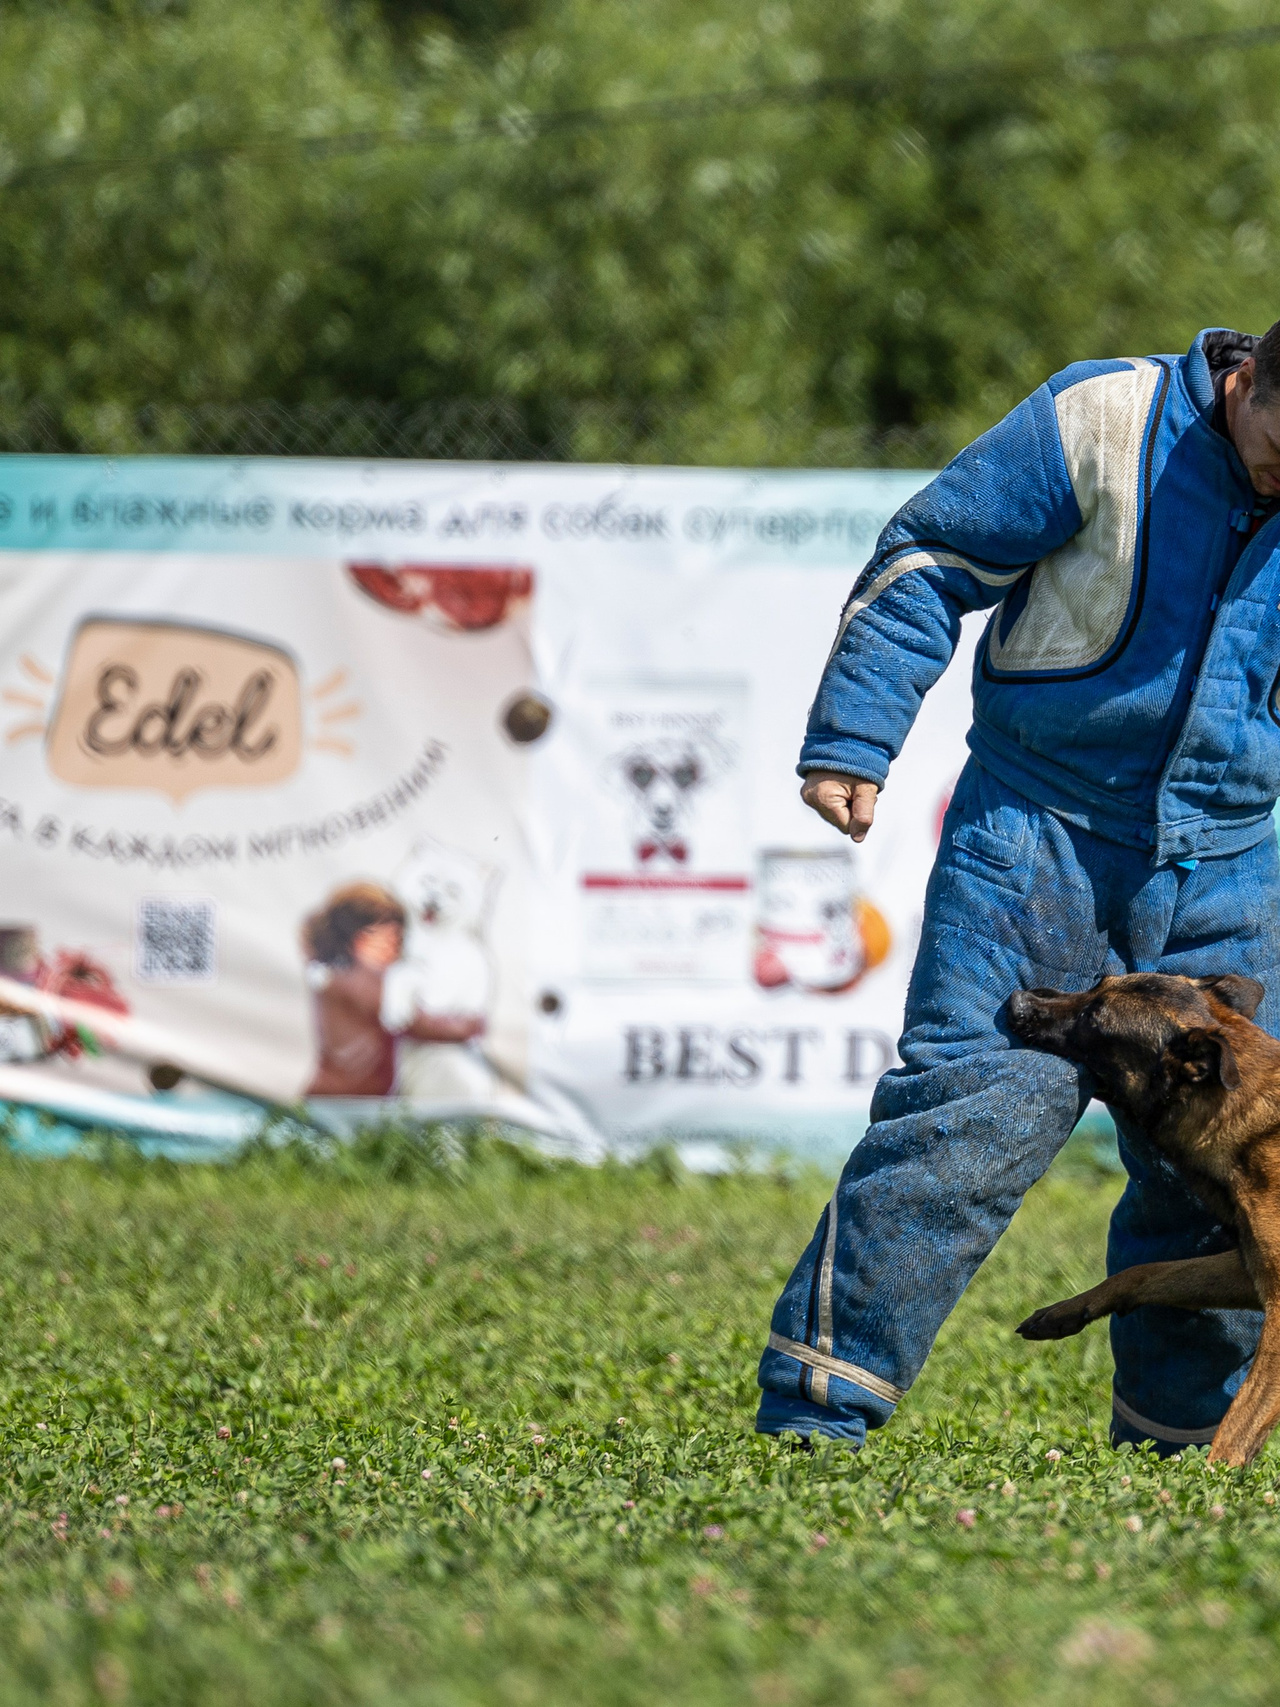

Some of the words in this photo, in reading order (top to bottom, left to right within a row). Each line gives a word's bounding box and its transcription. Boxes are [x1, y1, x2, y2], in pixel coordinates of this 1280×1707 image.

[288, 503, 428, 543] корма
[439, 504, 529, 543] для
[540, 493, 670, 542] собак
[82, 663, 278, 764] Edel
[621, 1026, 821, 1083] BEST
